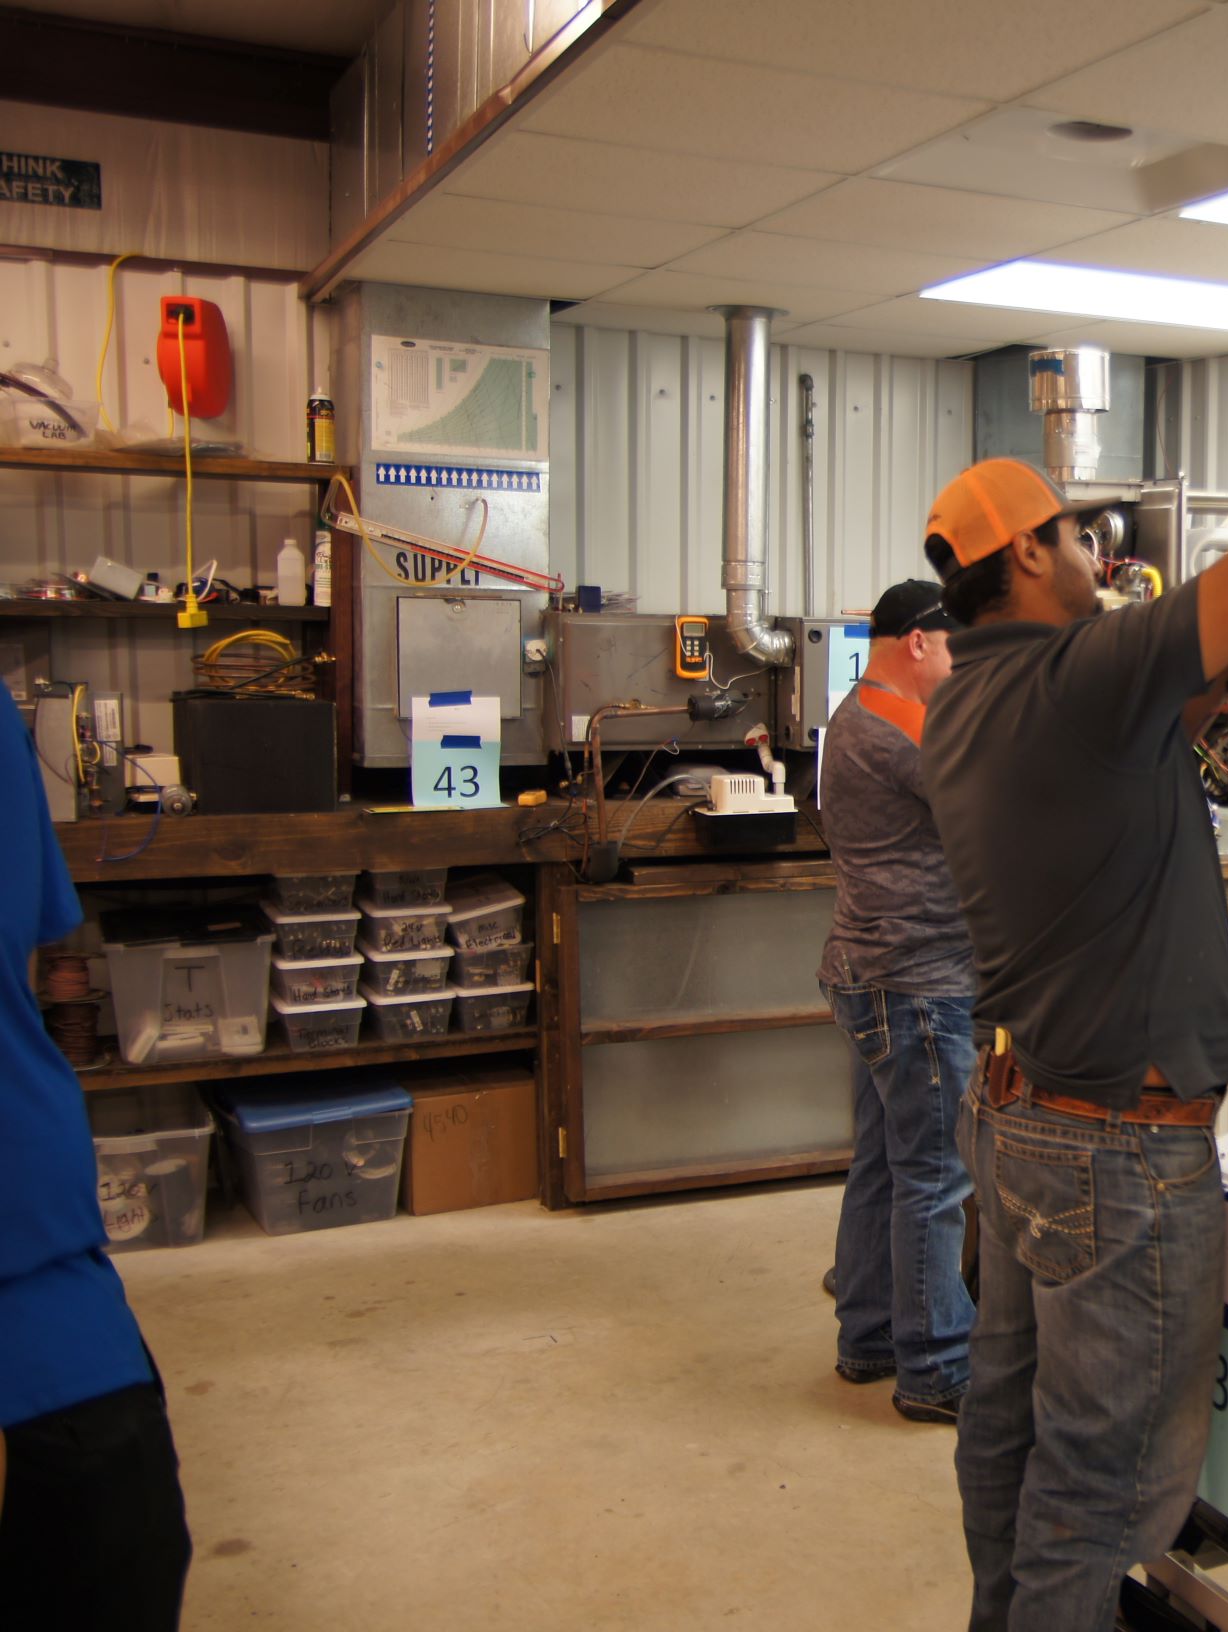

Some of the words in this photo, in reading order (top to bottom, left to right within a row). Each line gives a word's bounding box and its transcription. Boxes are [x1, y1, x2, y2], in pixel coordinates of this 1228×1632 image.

[1, 153, 64, 179] HINK
[0, 176, 75, 204] AFETY
[42, 431, 66, 440] LAB
[433, 765, 480, 798] 43
[173, 964, 206, 992] T
[284, 1160, 333, 1184] 120
[298, 1188, 357, 1216] Fans
